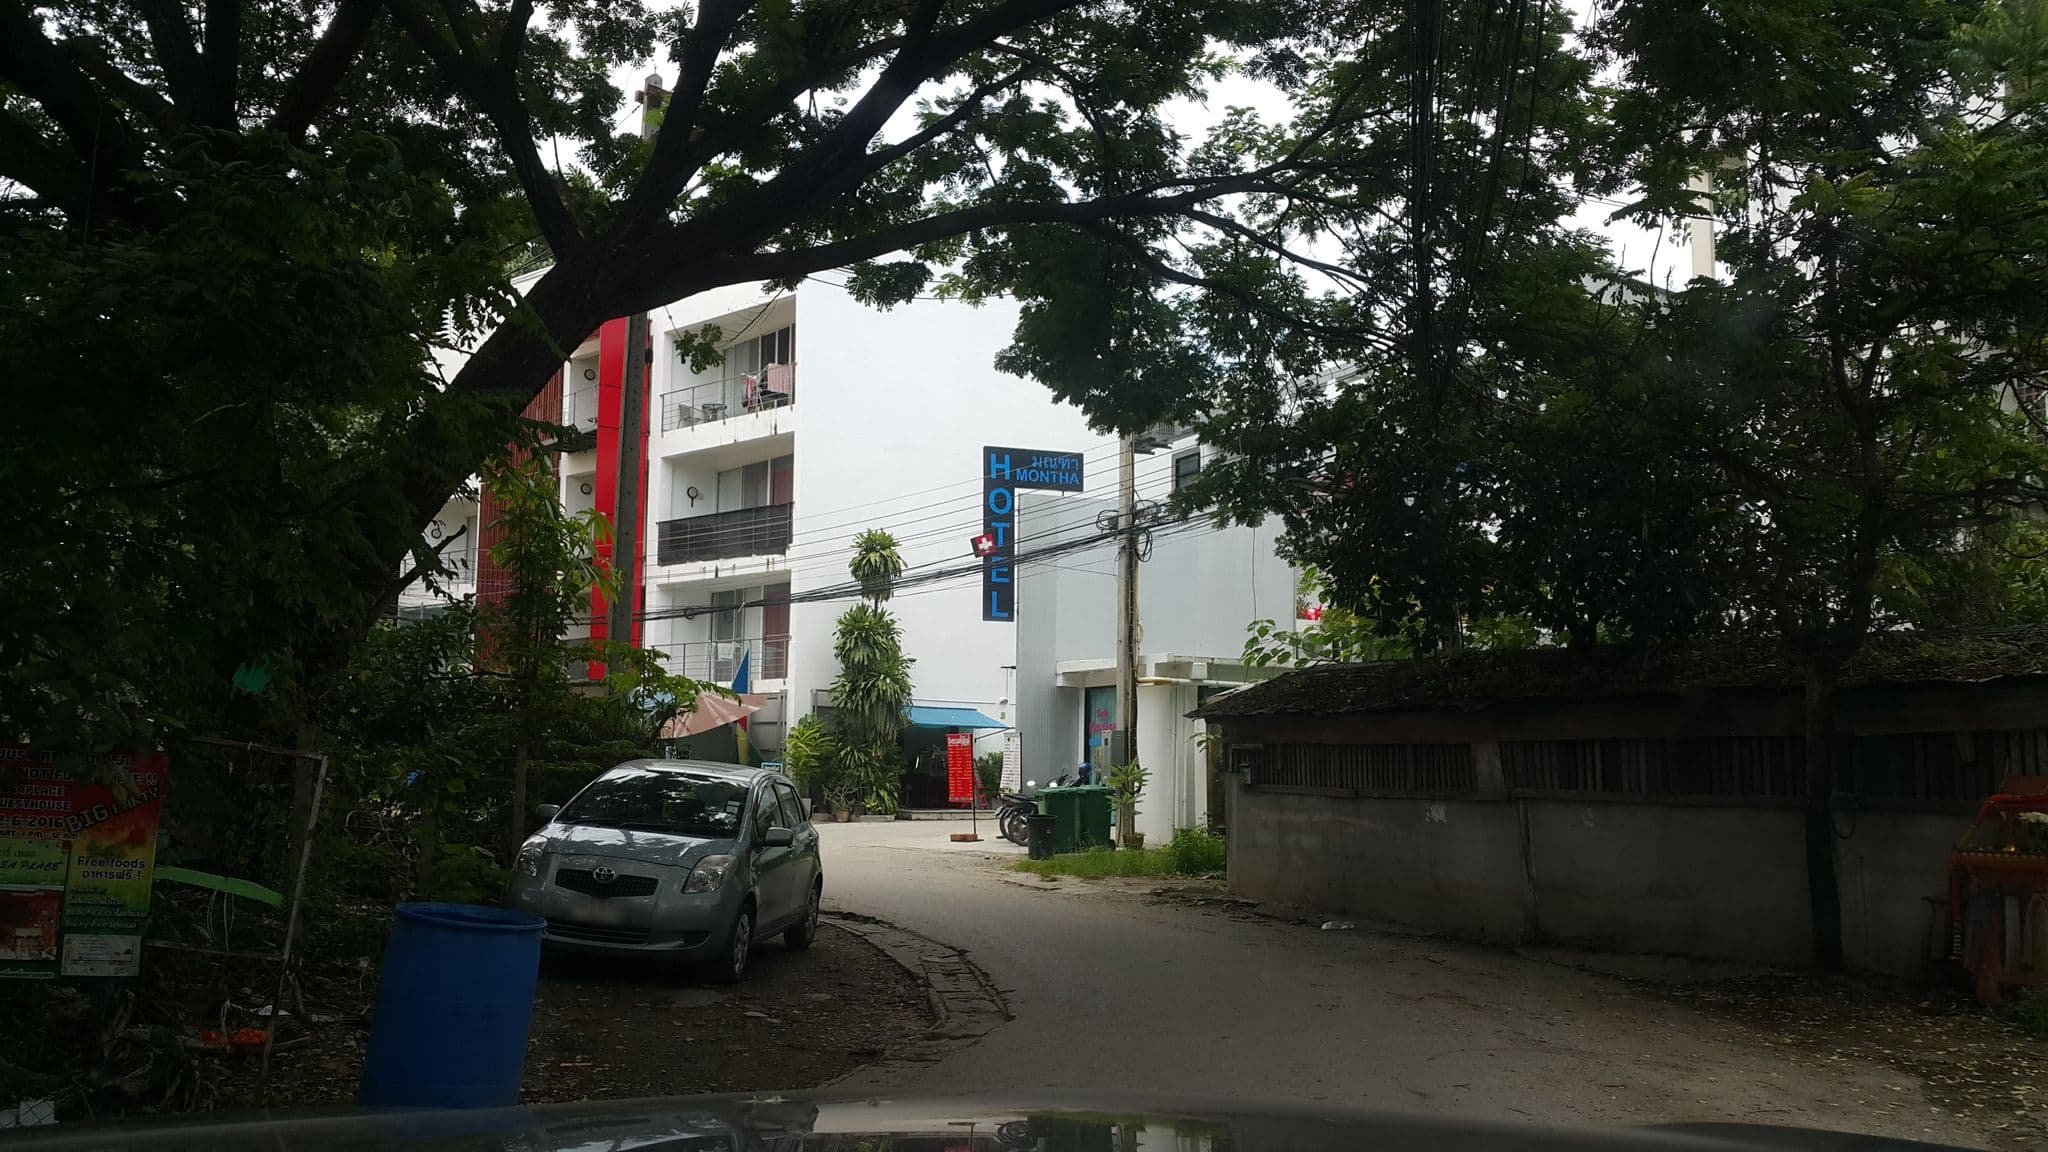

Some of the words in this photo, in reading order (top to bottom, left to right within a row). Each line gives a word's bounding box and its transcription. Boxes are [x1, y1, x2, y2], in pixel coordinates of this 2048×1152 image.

[1016, 469, 1080, 485] MONTHA
[989, 453, 1013, 618] HOTEL
[65, 803, 109, 832] BIG
[20, 860, 63, 872] PLACE
[76, 855, 107, 868] Free
[109, 857, 146, 870] foods
